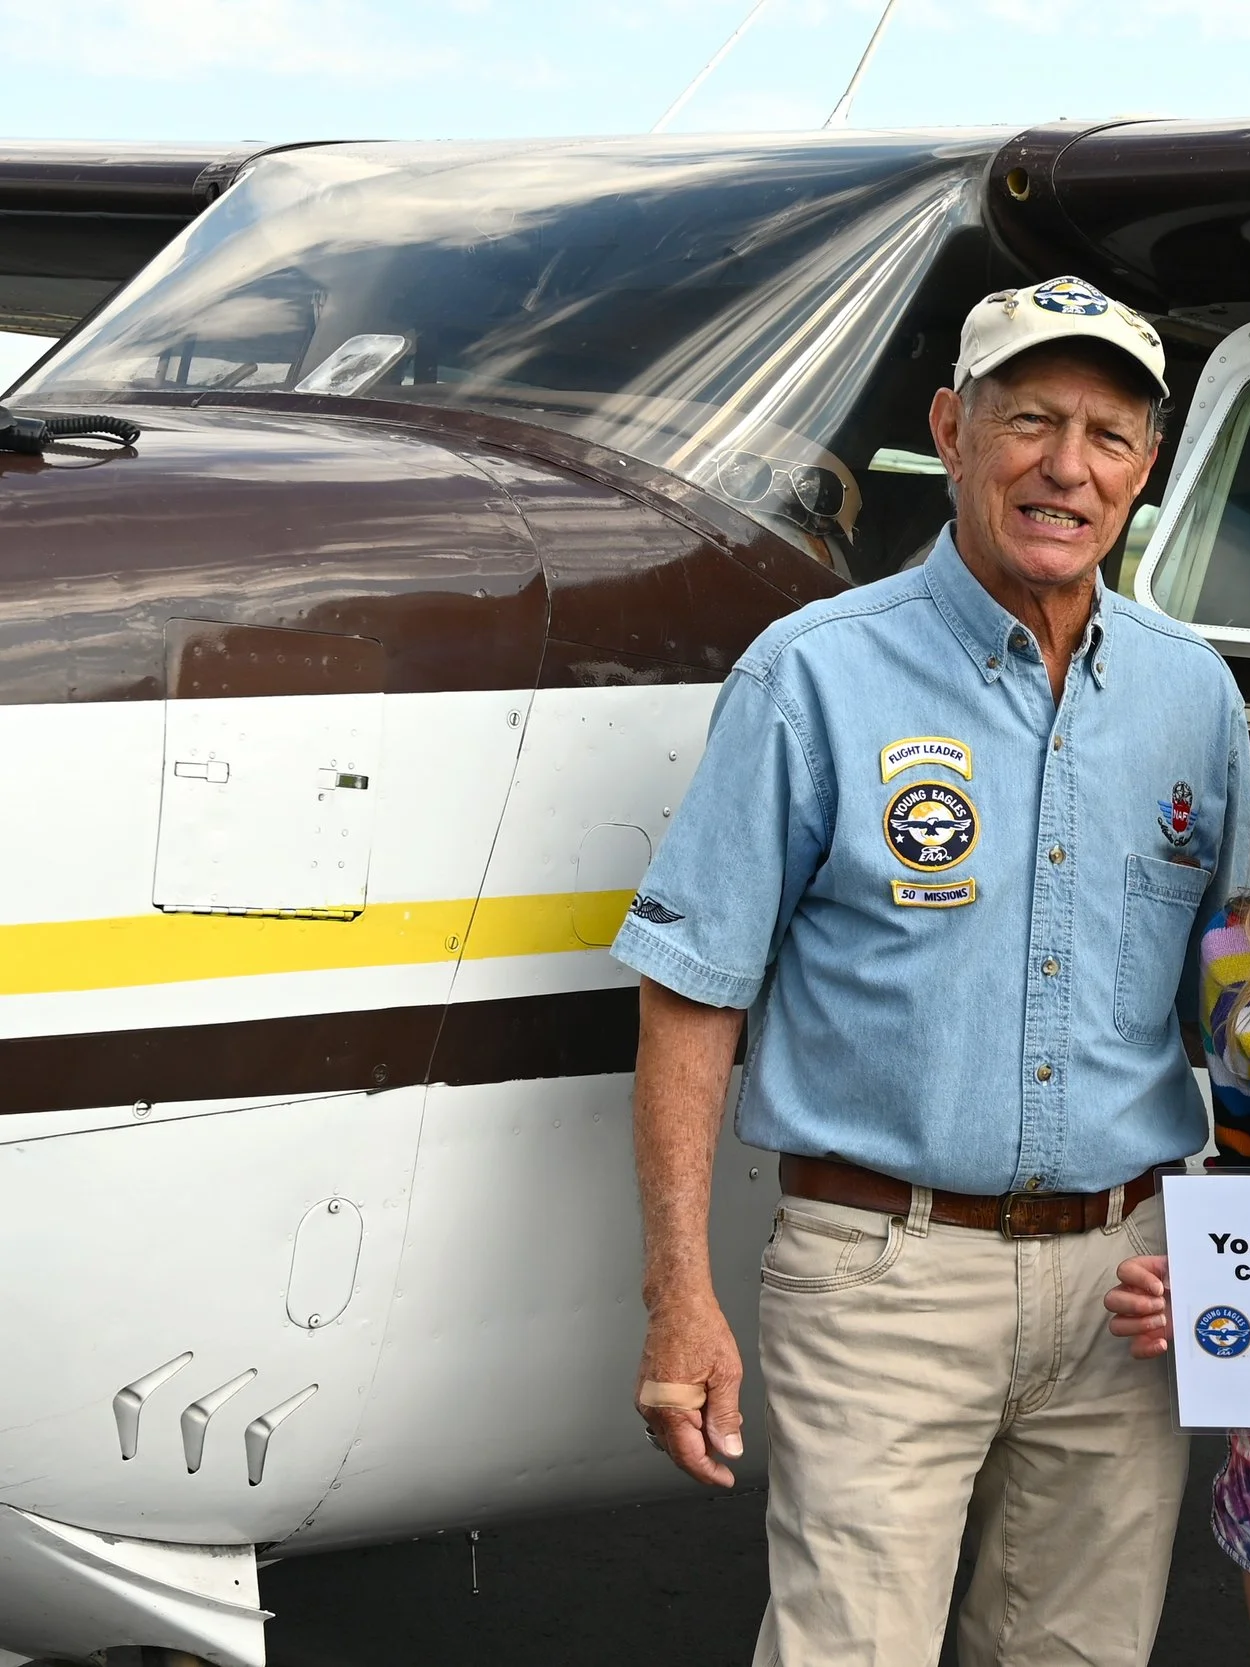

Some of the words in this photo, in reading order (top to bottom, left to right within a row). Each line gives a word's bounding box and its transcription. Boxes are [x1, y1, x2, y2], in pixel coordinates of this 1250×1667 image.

[888, 745, 920, 764] FLIGHT
[923, 744, 963, 761] LEADER
[894, 790, 926, 816] YOUNG
[931, 789, 966, 817] EAGLES
[901, 889, 915, 899] 50
[924, 888, 968, 901] MISSIONS
[1200, 1309, 1221, 1326] YOUNG
[1223, 1309, 1246, 1327] EAGLES
